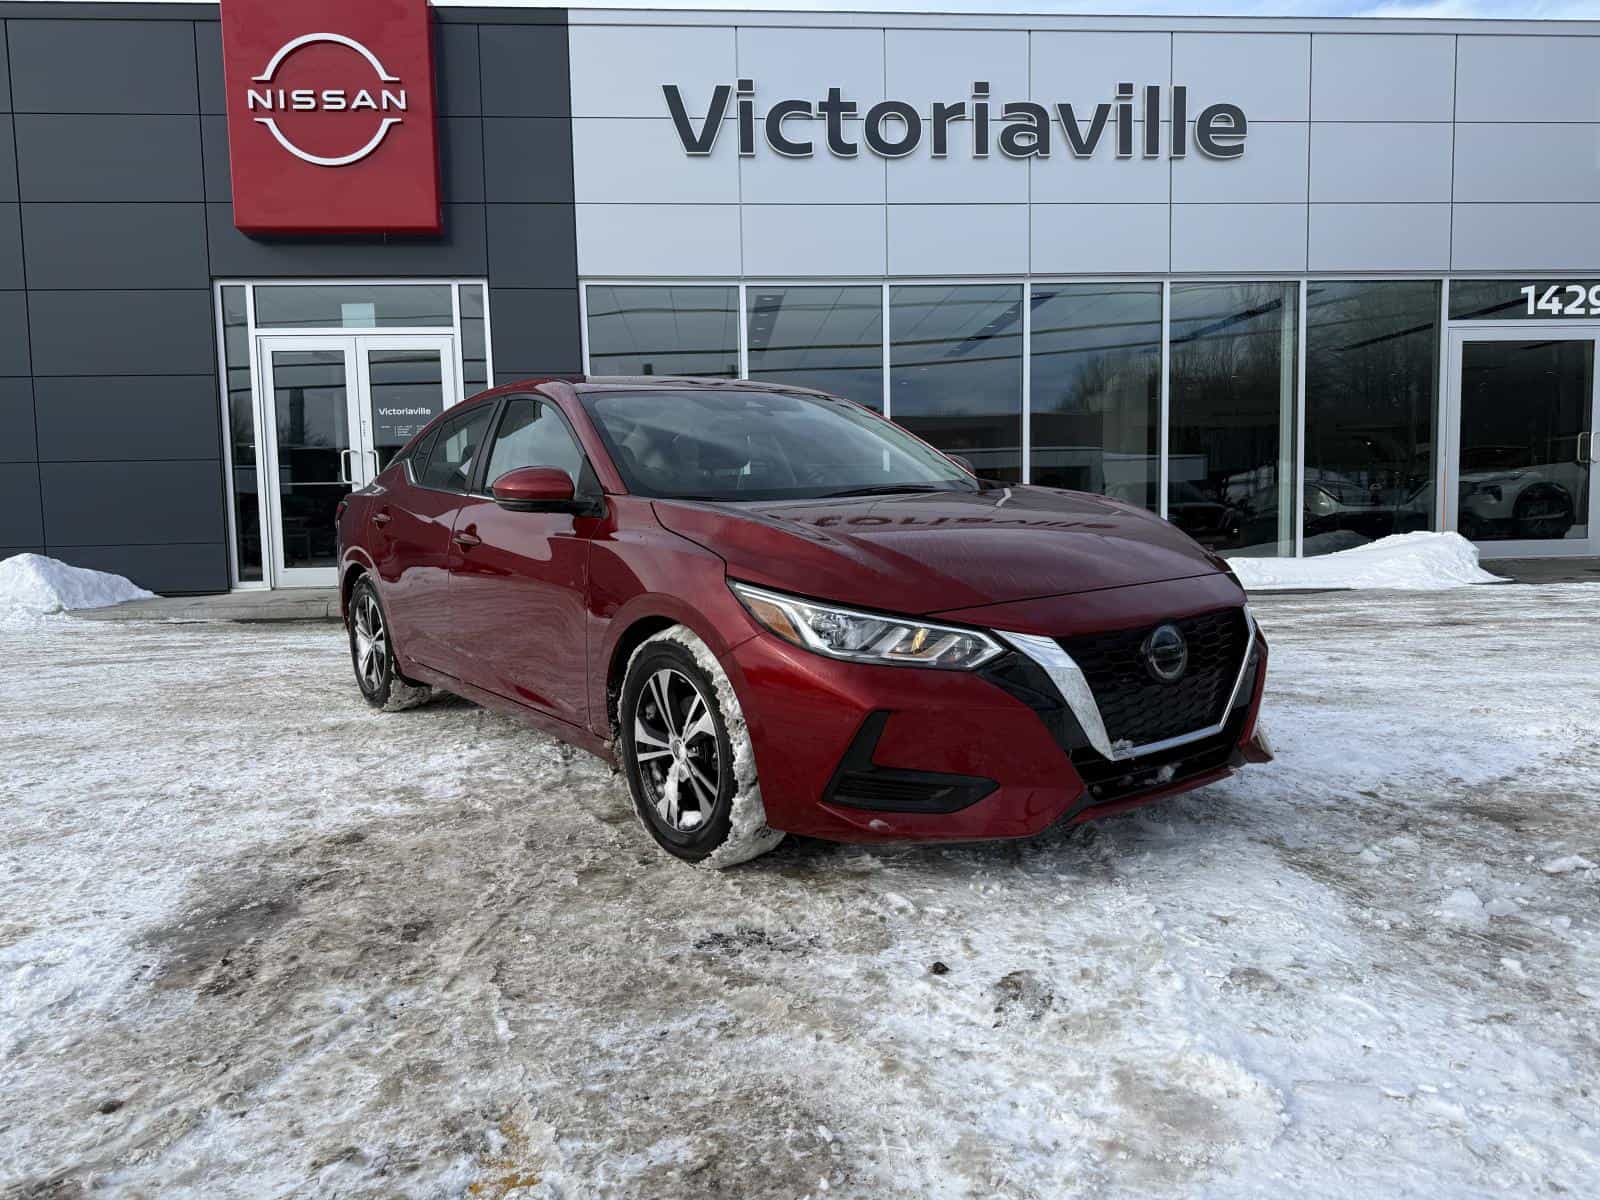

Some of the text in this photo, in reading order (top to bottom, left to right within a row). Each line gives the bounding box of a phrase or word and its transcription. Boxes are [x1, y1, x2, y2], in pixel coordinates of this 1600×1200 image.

[246, 88, 407, 111] NISSAN
[661, 78, 1249, 159] Victoriaville
[378, 407, 432, 416] Victoriaville
